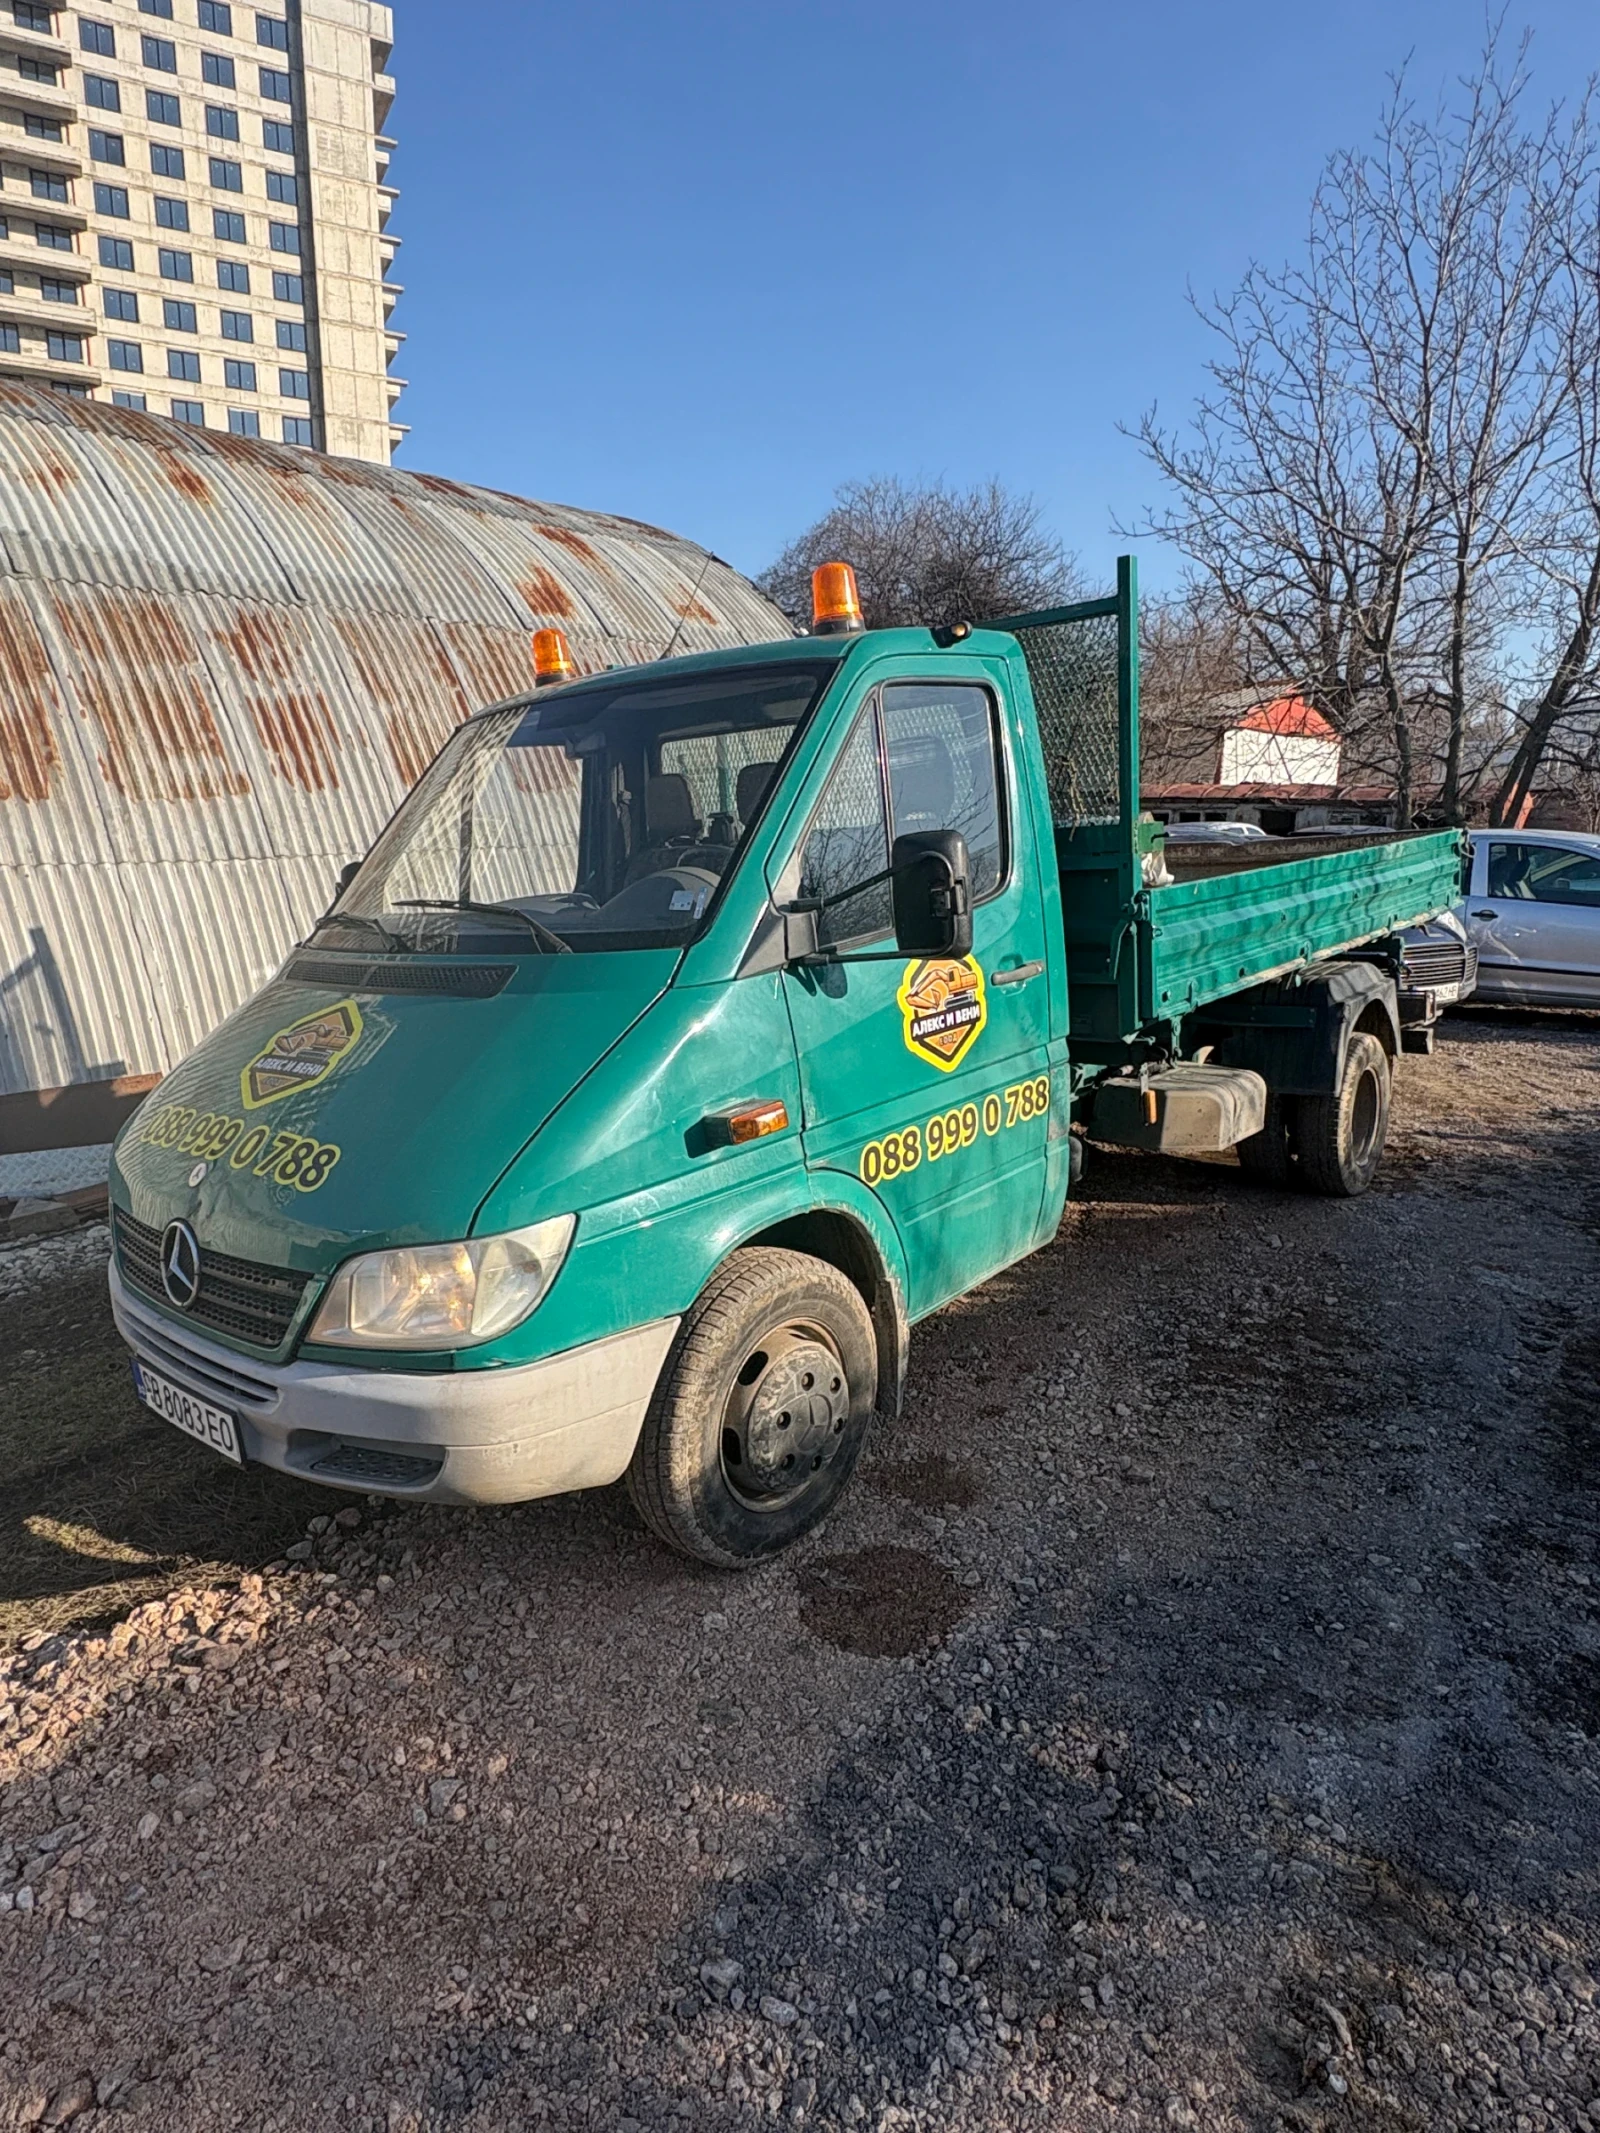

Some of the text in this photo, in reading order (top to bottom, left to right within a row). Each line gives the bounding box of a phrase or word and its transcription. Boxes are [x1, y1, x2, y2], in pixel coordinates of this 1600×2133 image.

[912, 1004, 980, 1038] АЛЕКС И ВЕНИ
[254, 1057, 289, 1071] АЛЕКС
[282, 1060, 298, 1073] И
[141, 1105, 341, 1193] 088 999 0 788
[860, 1075, 1049, 1187] 088 999 0 788
